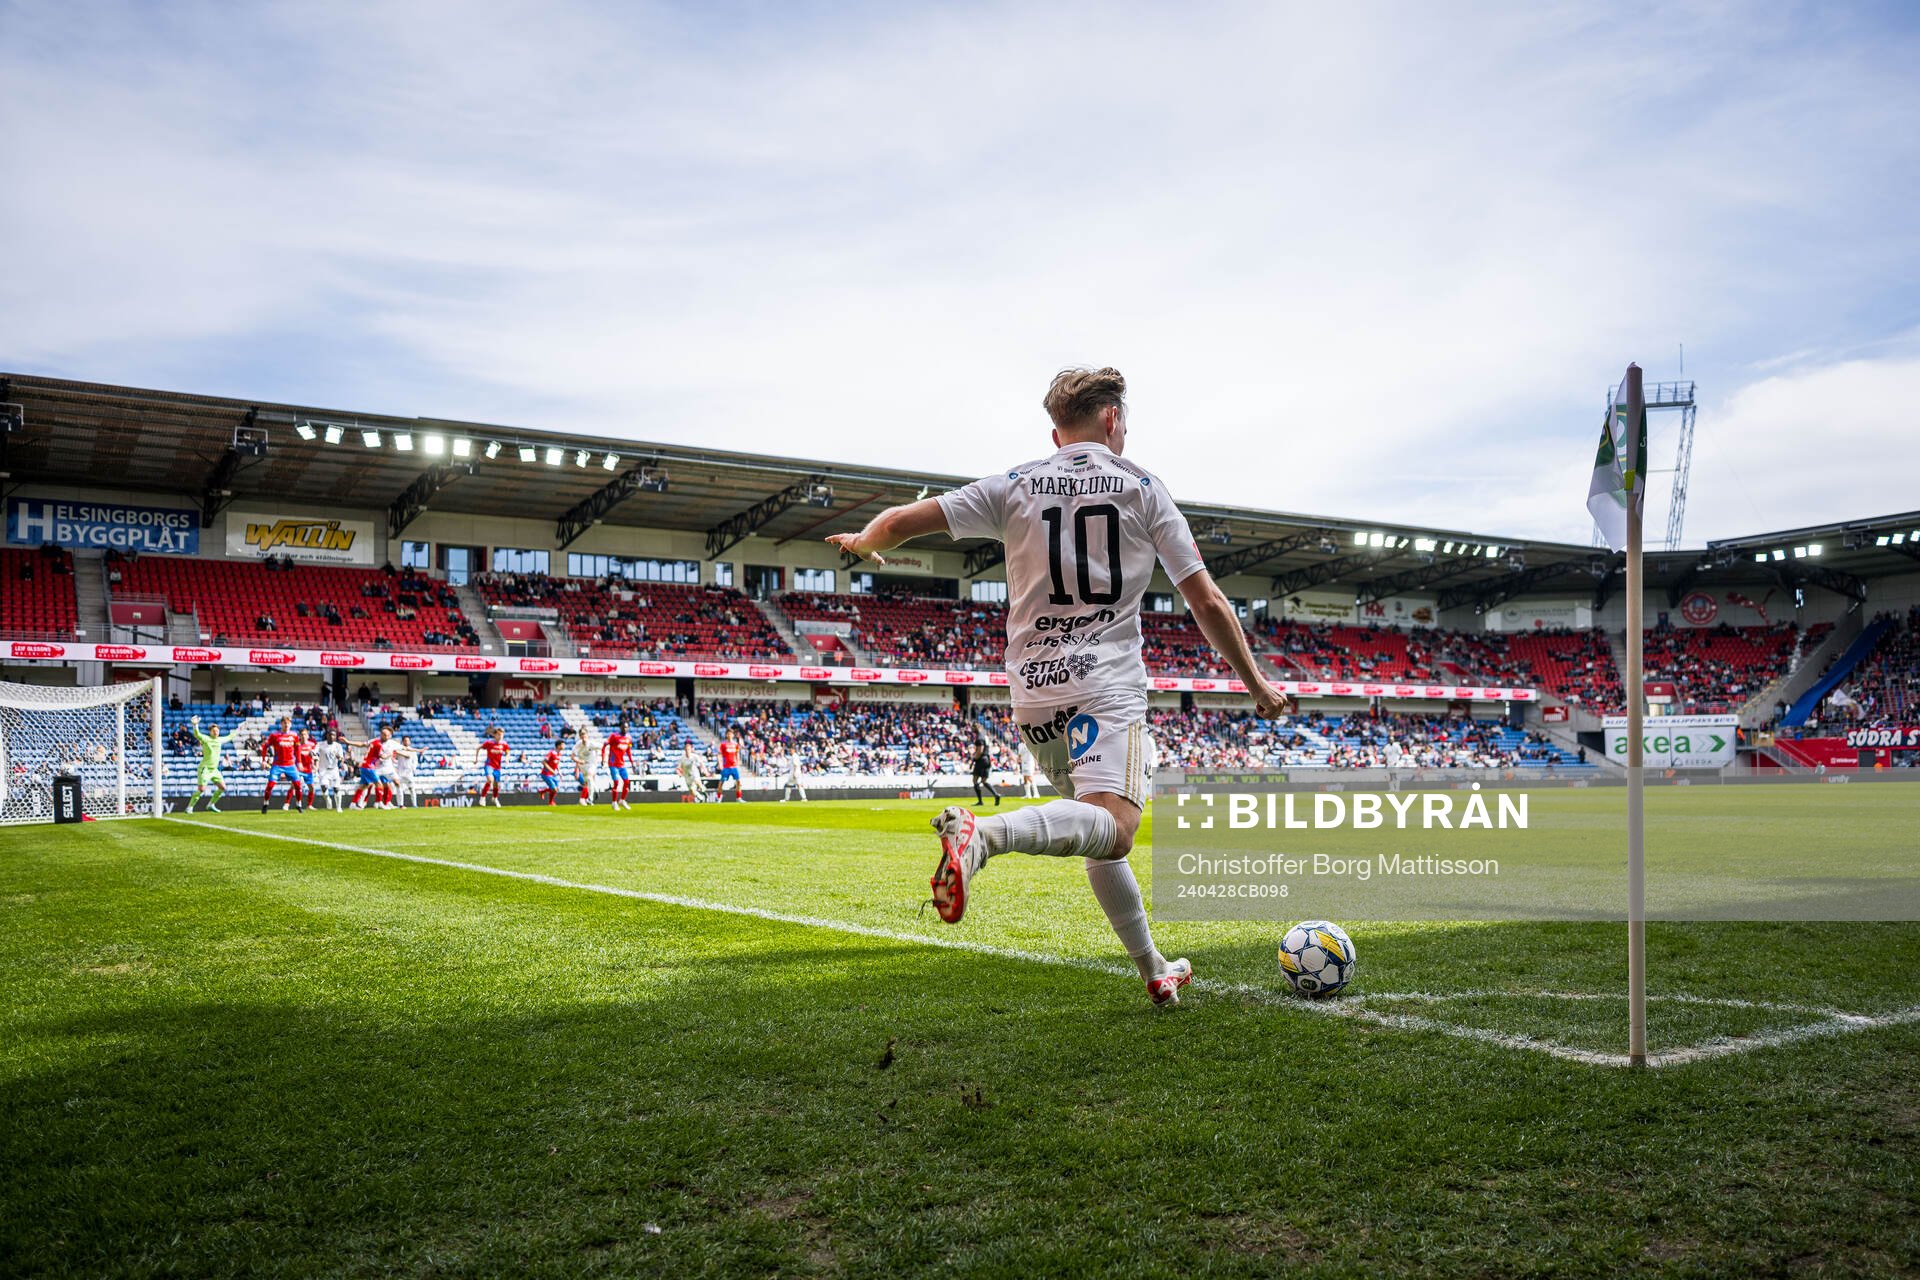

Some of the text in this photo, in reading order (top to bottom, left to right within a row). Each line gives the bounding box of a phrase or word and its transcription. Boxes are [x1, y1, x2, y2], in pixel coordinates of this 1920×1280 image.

[1030, 475, 1124, 497] MARKLUND
[57, 523, 190, 549] BYGGPLÅT
[245, 520, 356, 551] WALLIN
[1041, 504, 1123, 605] 10
[1020, 656, 1066, 676] ÖSTER
[555, 679, 648, 694] Det är kärlek
[1026, 668, 1070, 690] SUND
[700, 681, 779, 698] ikväll syster
[856, 686, 906, 699] och bror
[1847, 728, 1902, 746] SÖDRA
[62, 785, 74, 818] SELECT
[424, 797, 474, 808] reunify
[899, 789, 935, 800] reunify
